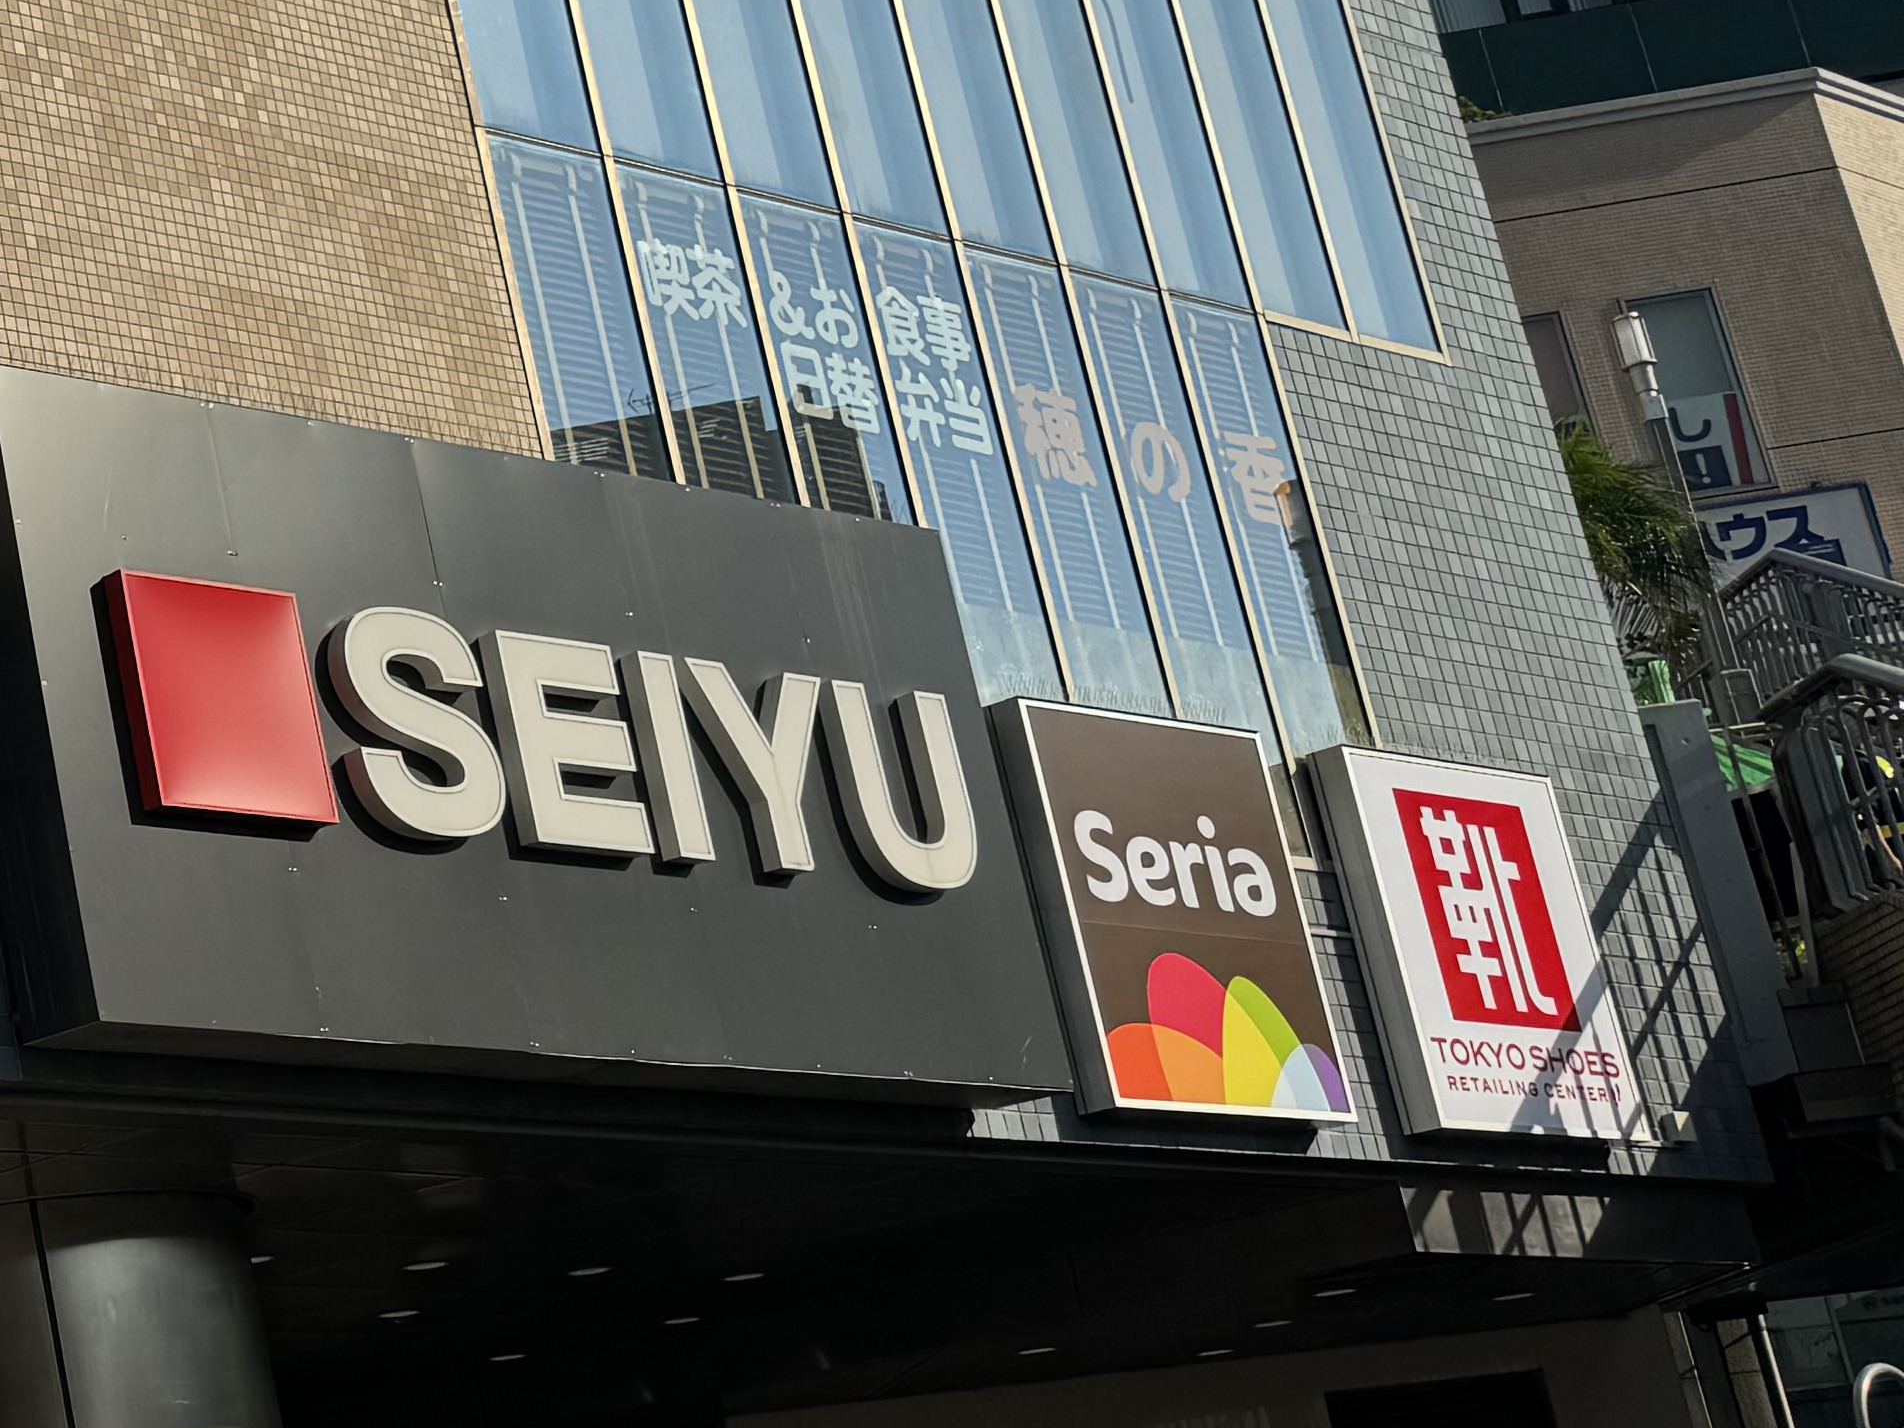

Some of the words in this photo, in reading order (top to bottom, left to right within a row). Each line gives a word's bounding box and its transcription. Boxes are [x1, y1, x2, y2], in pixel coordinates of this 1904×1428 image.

[330, 605, 978, 892] SEIYU
[1072, 809, 1278, 918] Seria
[1430, 1036, 1526, 1071] TOKYO
[1529, 1045, 1621, 1079] SHOES
[1447, 1075, 1539, 1098] RETAILING
